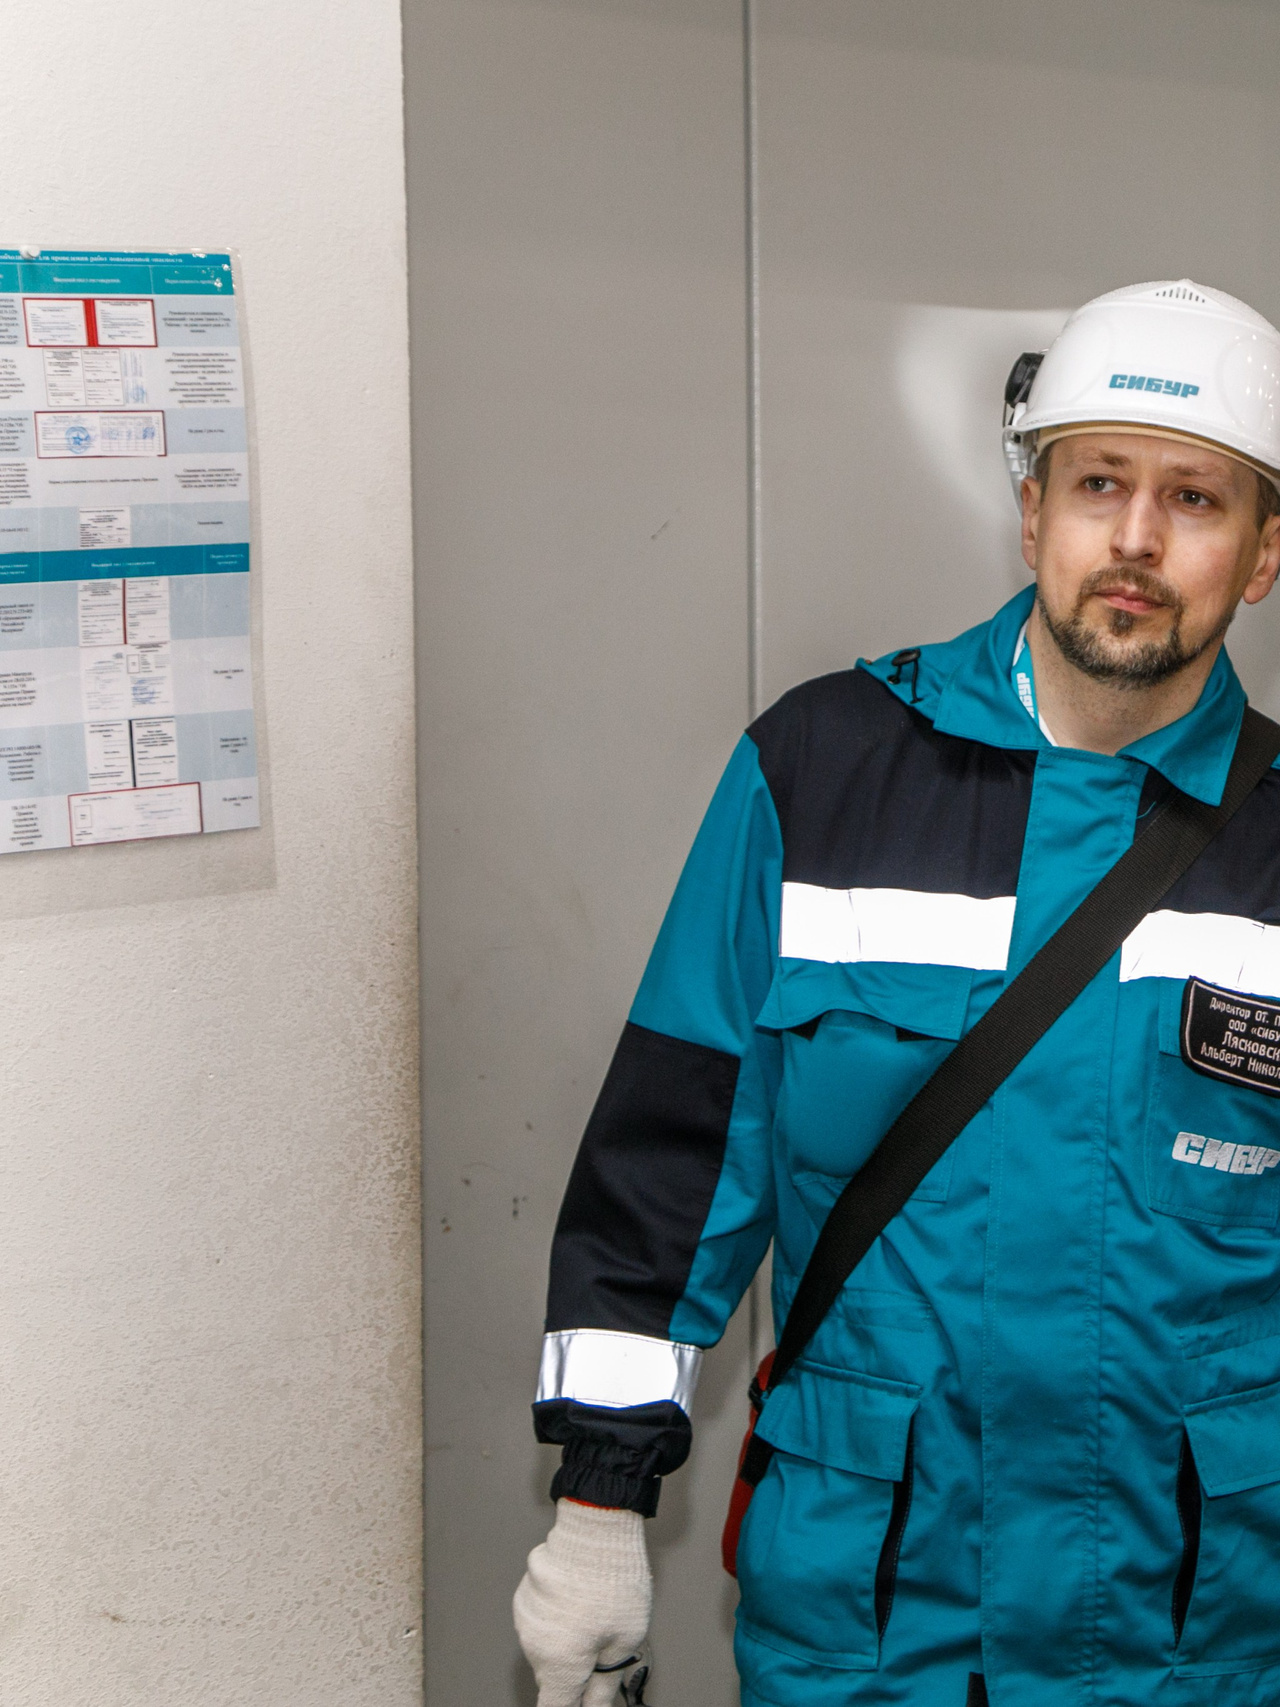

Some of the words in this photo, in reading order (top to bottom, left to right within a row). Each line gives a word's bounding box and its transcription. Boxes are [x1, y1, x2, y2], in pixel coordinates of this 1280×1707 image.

[1108, 374, 1200, 398] СИБУР
[1209, 997, 1251, 1020] Директор
[1228, 1019, 1247, 1033] ООО
[1200, 1042, 1245, 1068] Альберт
